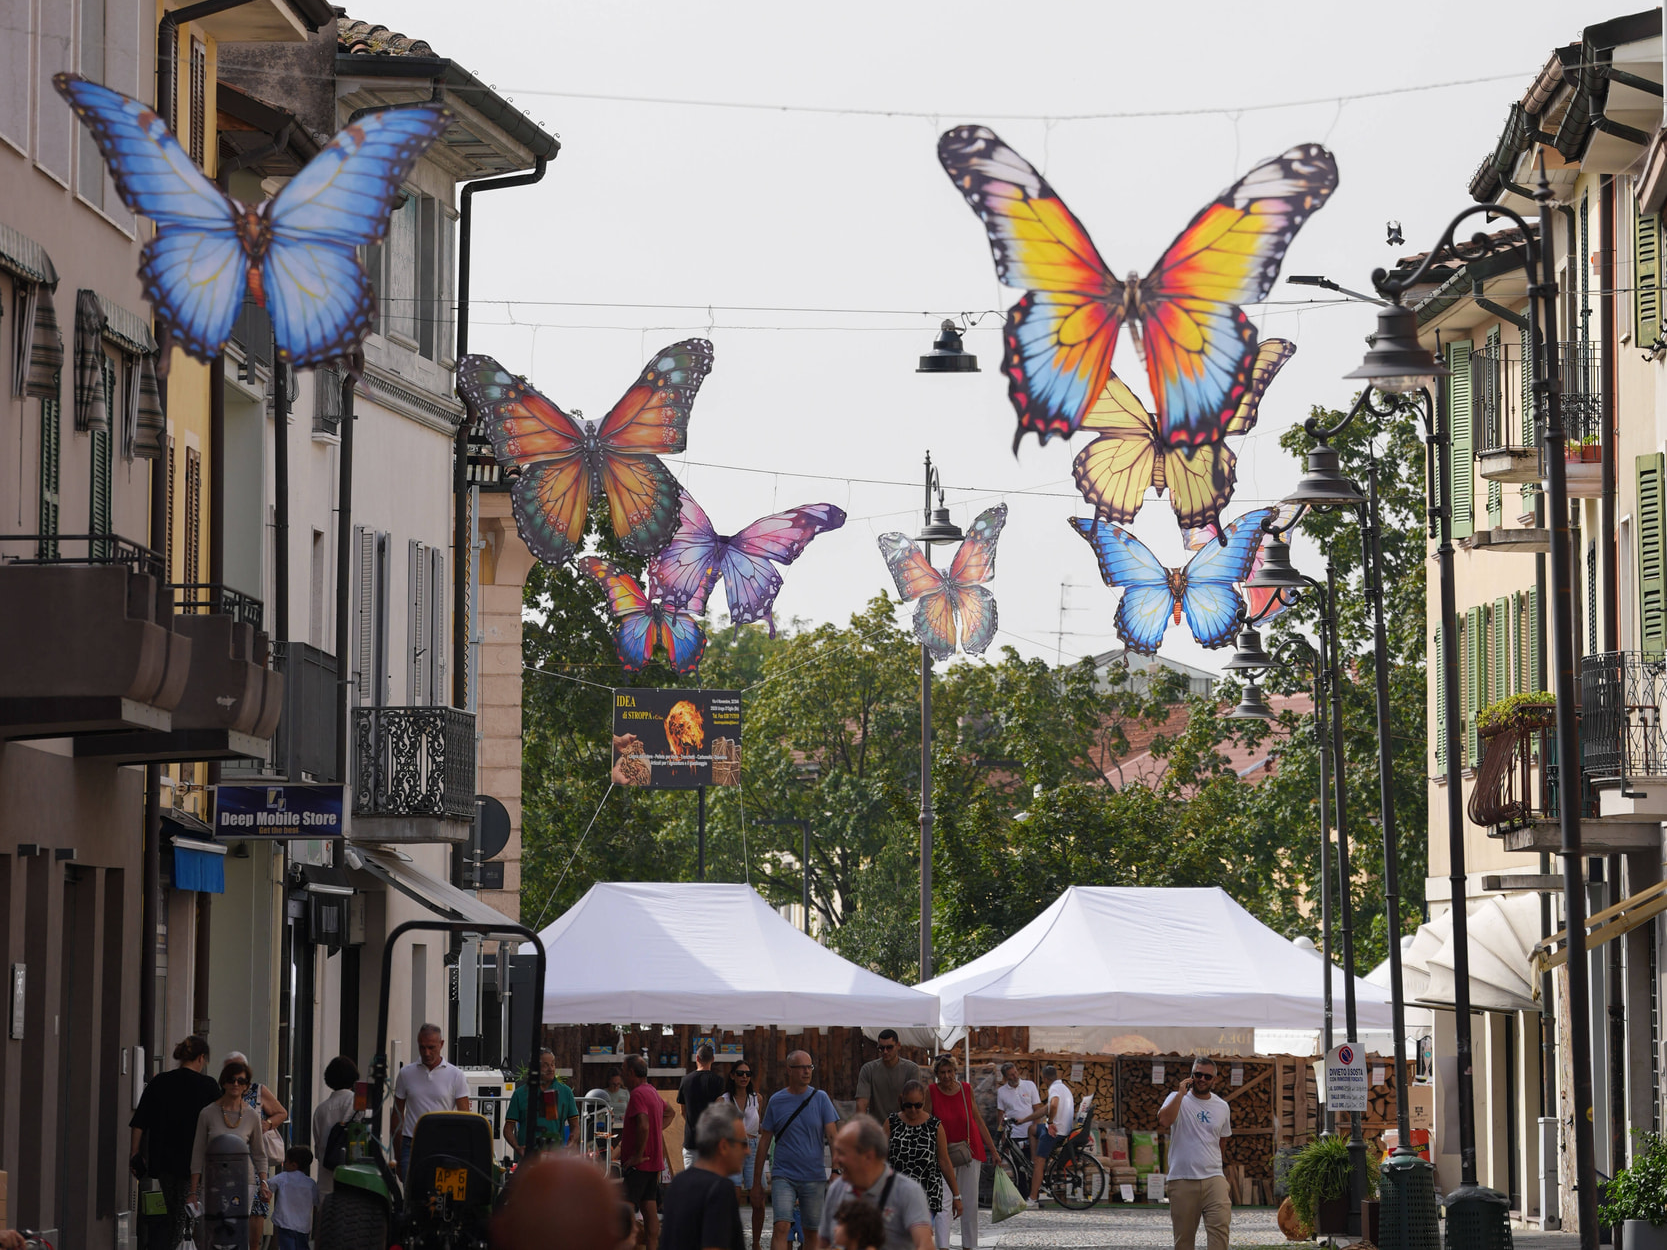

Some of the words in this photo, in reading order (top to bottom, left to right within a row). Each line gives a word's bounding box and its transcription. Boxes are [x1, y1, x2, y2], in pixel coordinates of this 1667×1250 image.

[616, 695, 636, 707] IDEA
[628, 711, 652, 720] STROPPA
[221, 812, 254, 827] Deep
[256, 812, 300, 825] Mobile
[302, 811, 337, 825] Store
[258, 826, 271, 834] Get
[271, 826, 283, 834] the
[283, 826, 299, 834] best
[1329, 1068, 1347, 1077] DIVIETO
